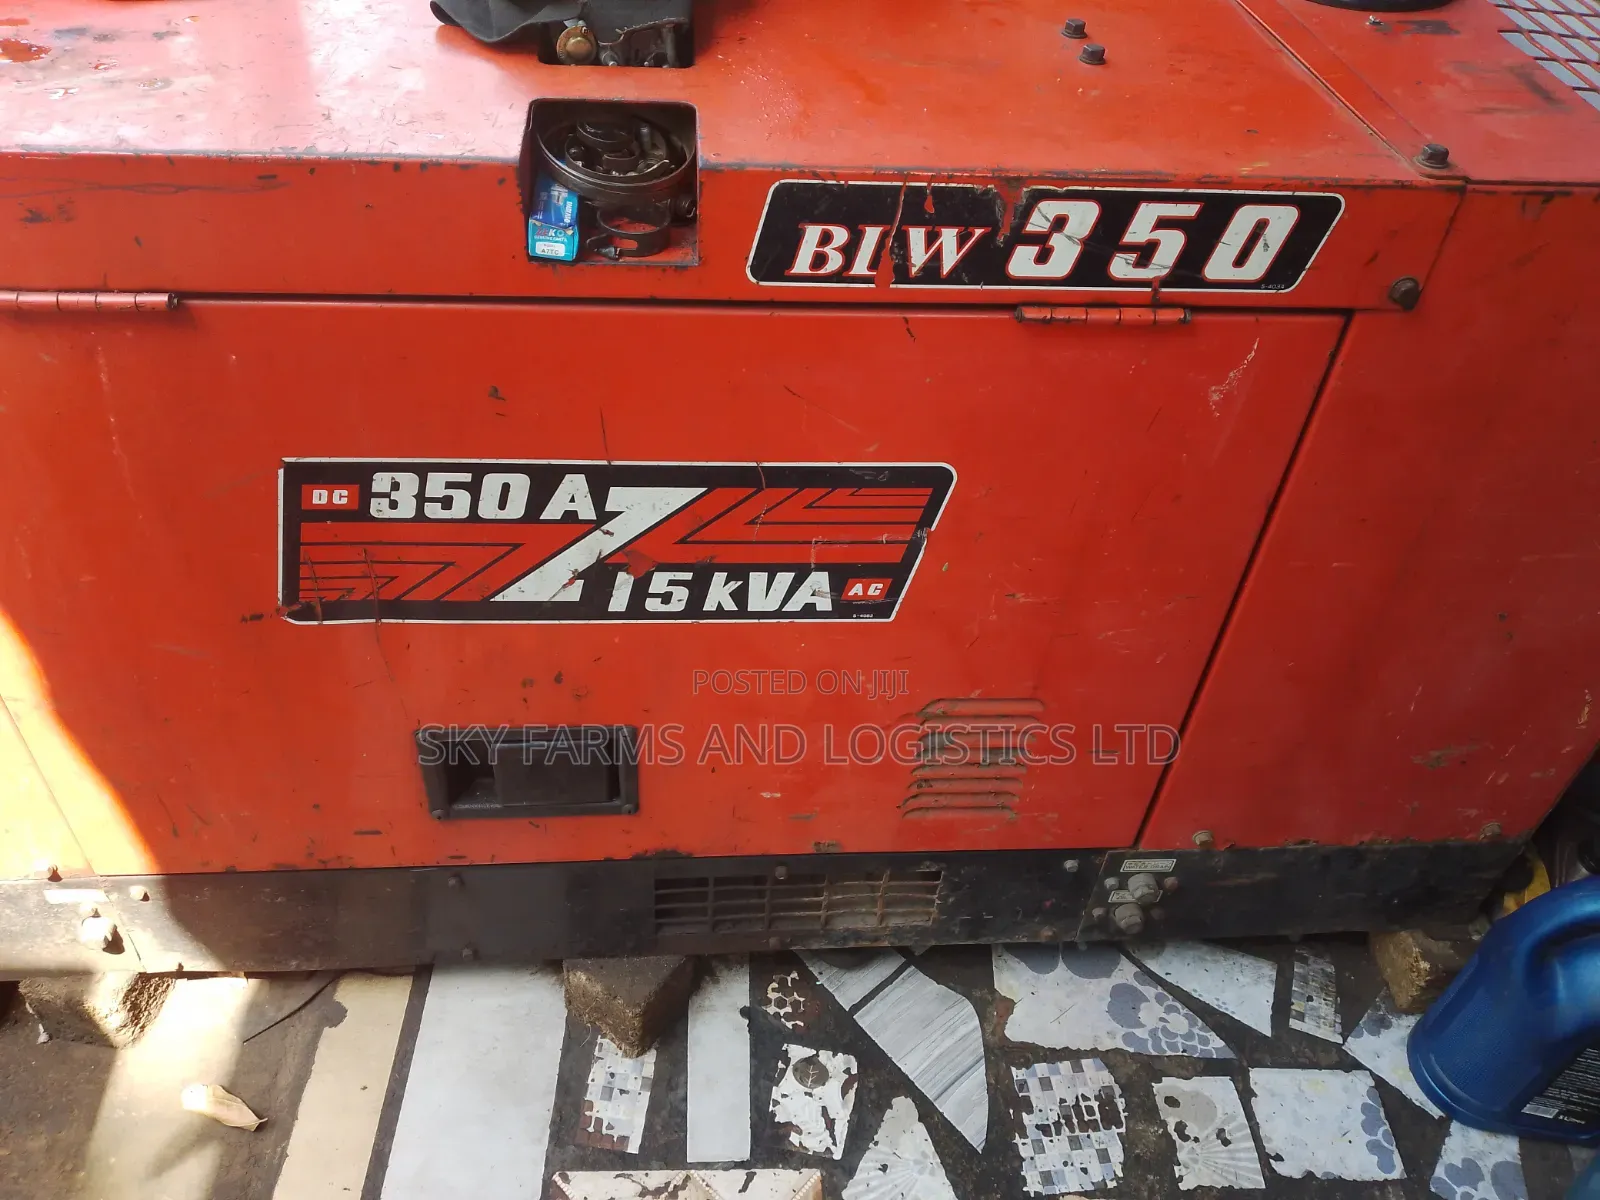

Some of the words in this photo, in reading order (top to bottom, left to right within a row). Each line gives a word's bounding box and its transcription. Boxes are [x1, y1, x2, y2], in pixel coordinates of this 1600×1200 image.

[1005, 199, 1300, 282] 350
[312, 489, 348, 505] DC
[369, 472, 531, 519] 350
[539, 473, 597, 520] A
[608, 571, 693, 612] 15
[702, 571, 833, 612] kVA
[848, 583, 884, 596] AC
